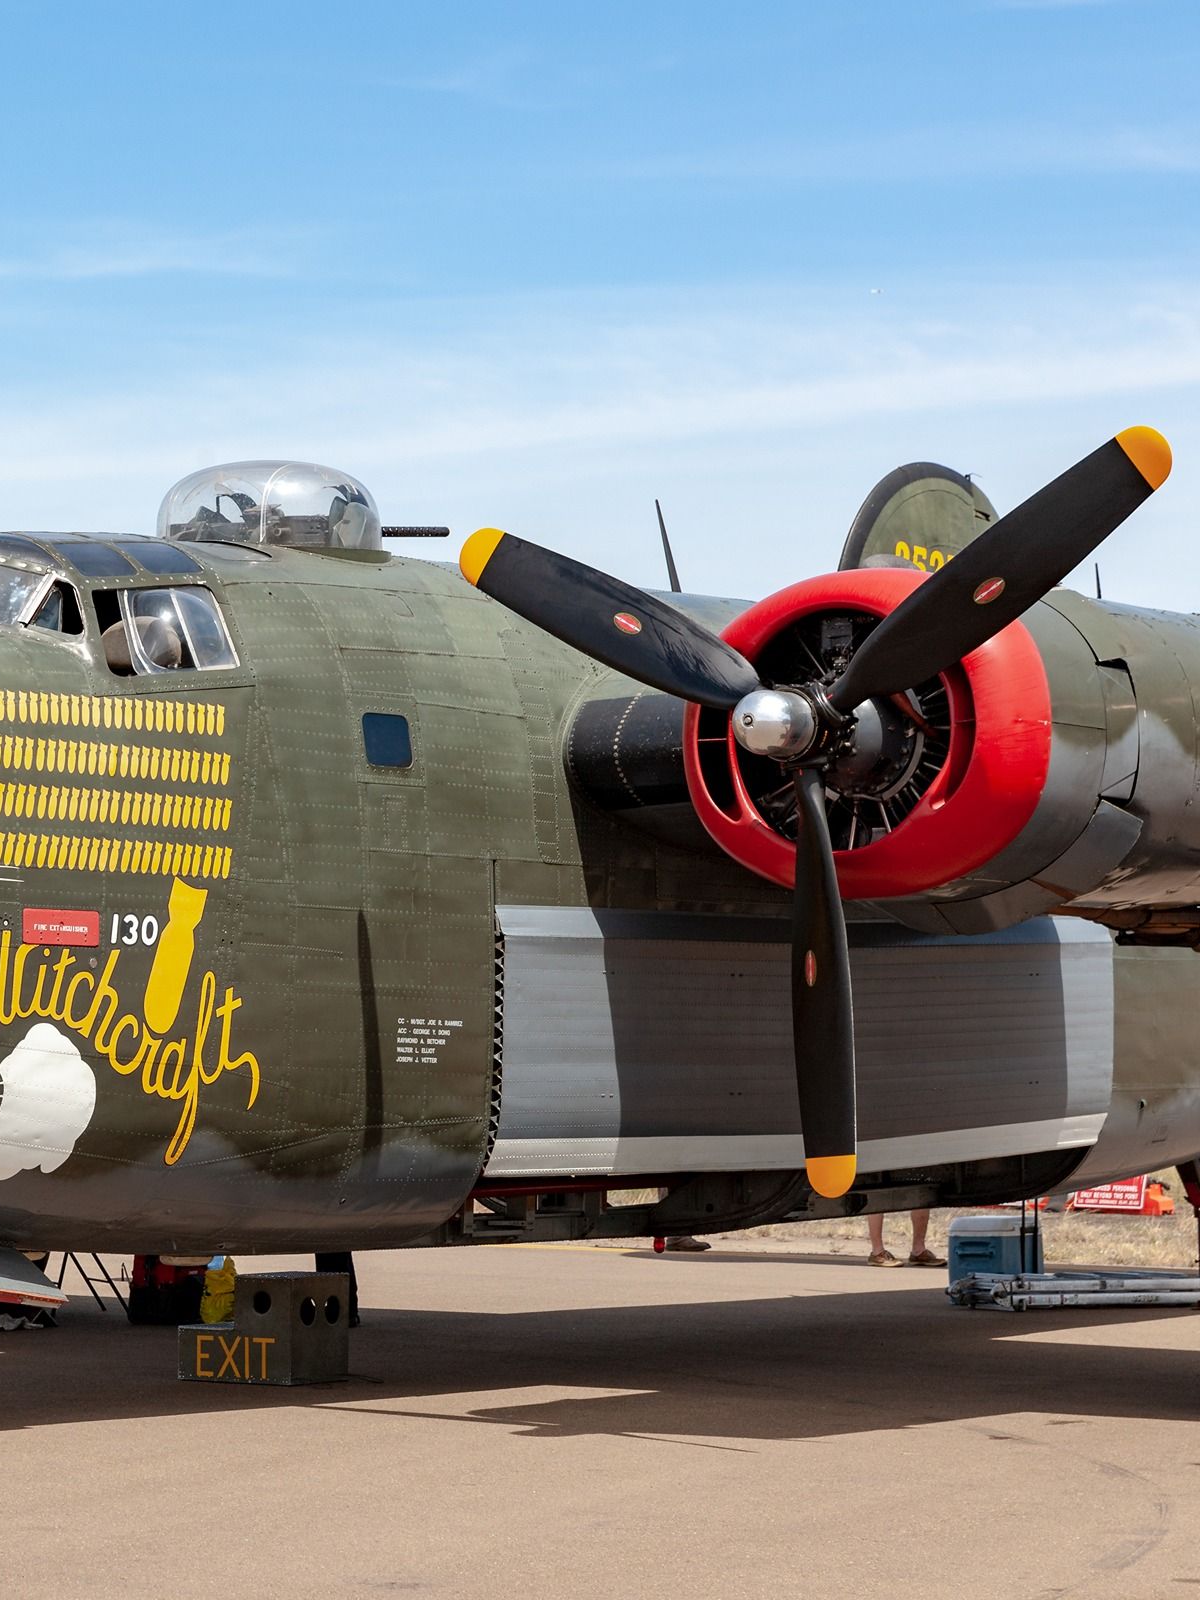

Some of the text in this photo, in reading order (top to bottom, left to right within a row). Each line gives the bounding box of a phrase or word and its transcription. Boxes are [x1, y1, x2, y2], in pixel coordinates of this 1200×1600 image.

[33, 923, 89, 933] FIRE EXTINGUISHER
[110, 913, 159, 946] 130
[196, 1335, 276, 1380] EXIT
